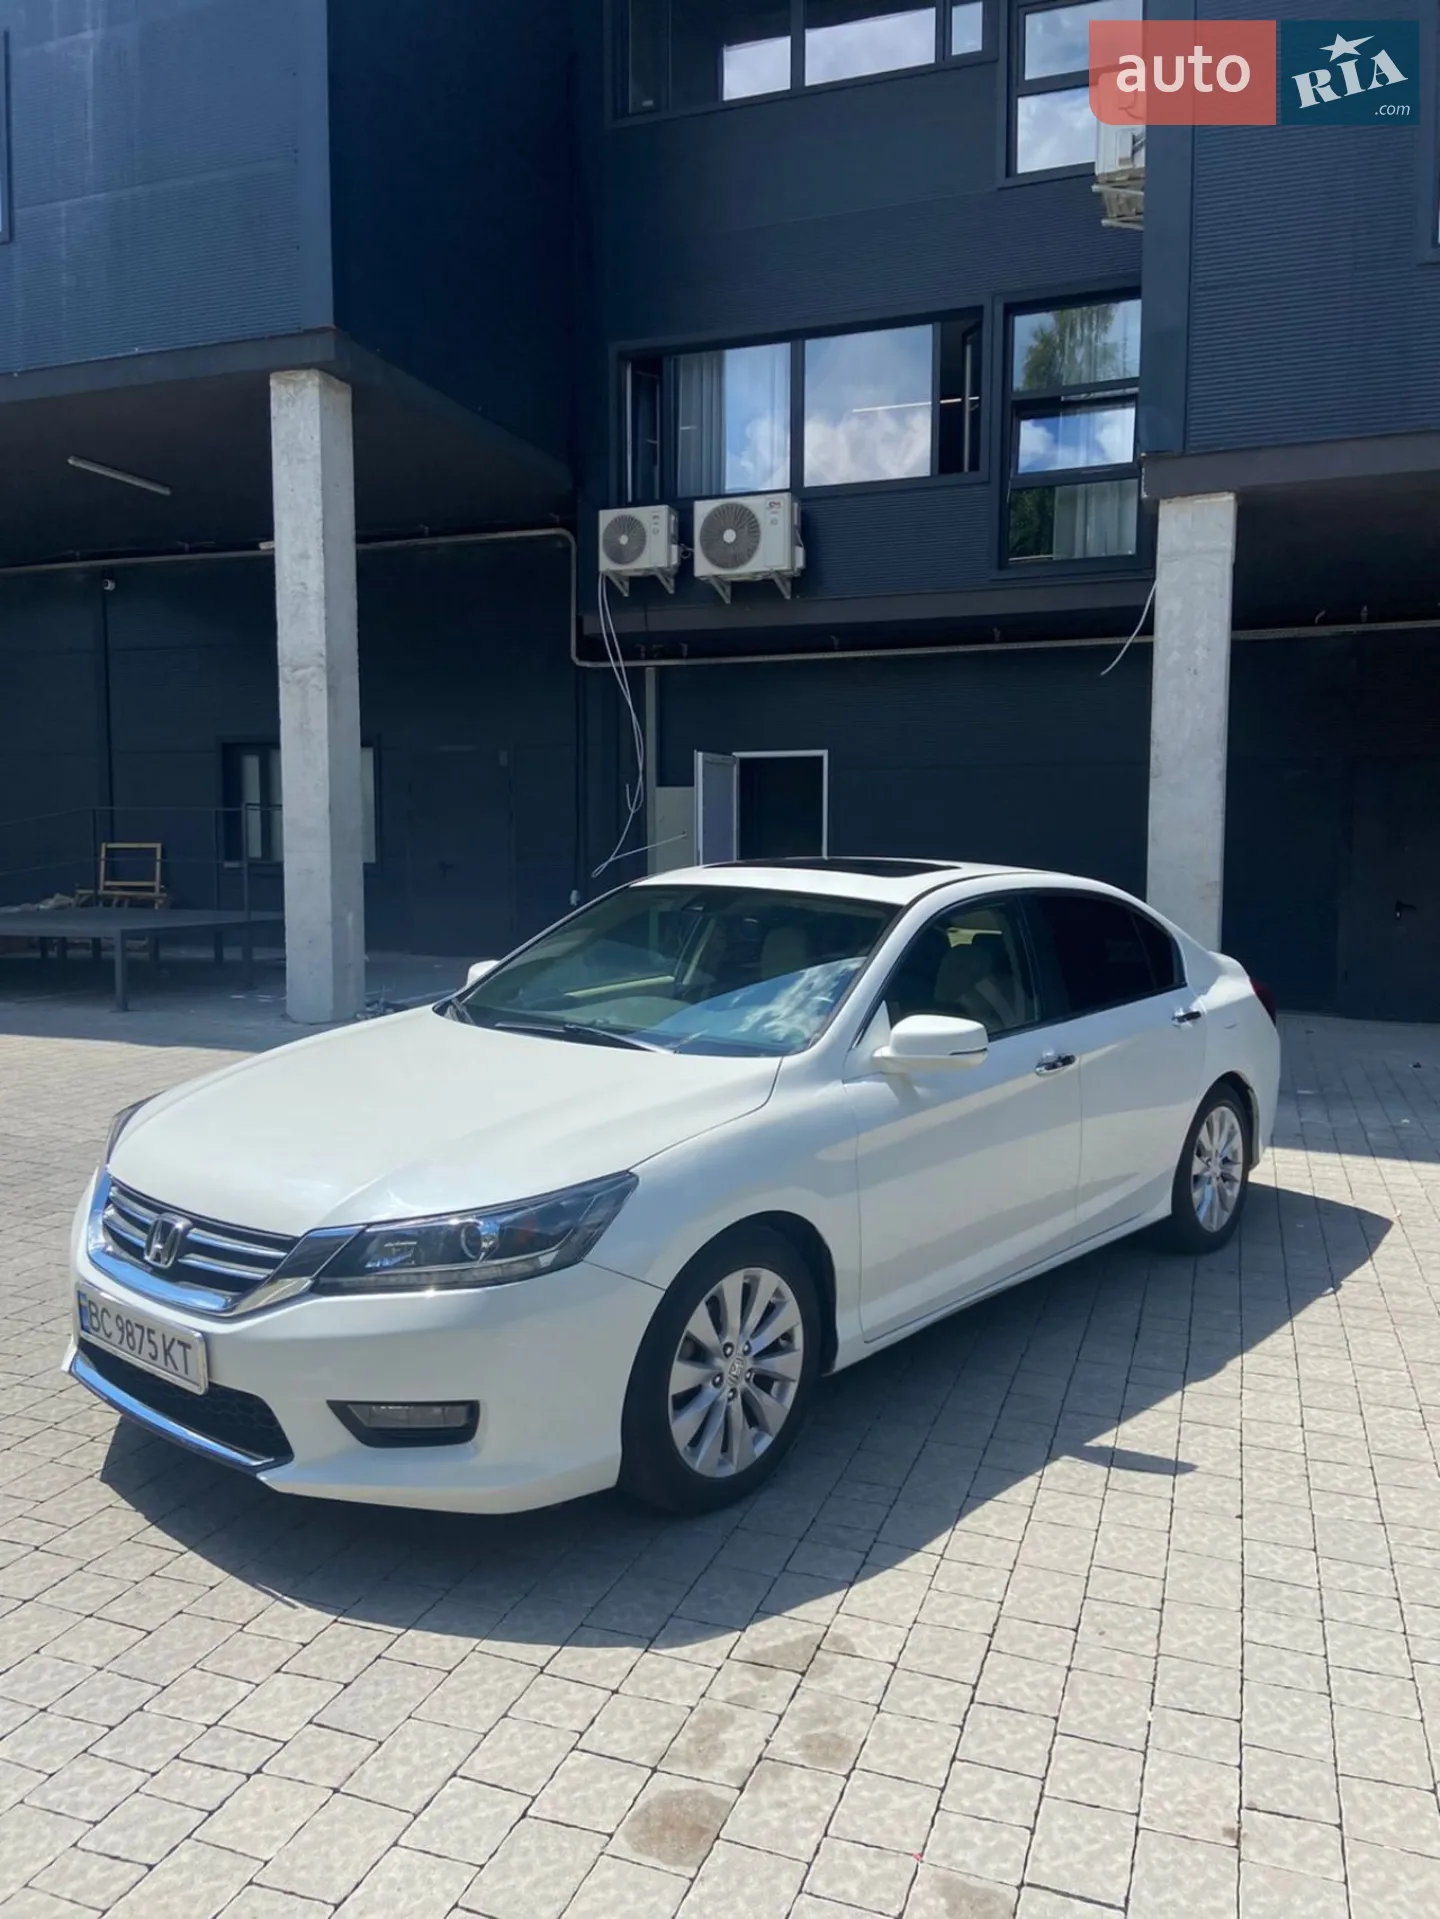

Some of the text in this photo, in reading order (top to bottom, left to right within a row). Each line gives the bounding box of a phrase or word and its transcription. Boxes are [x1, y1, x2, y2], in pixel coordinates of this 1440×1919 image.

[88, 1299, 192, 1376] BC 9875 KT
